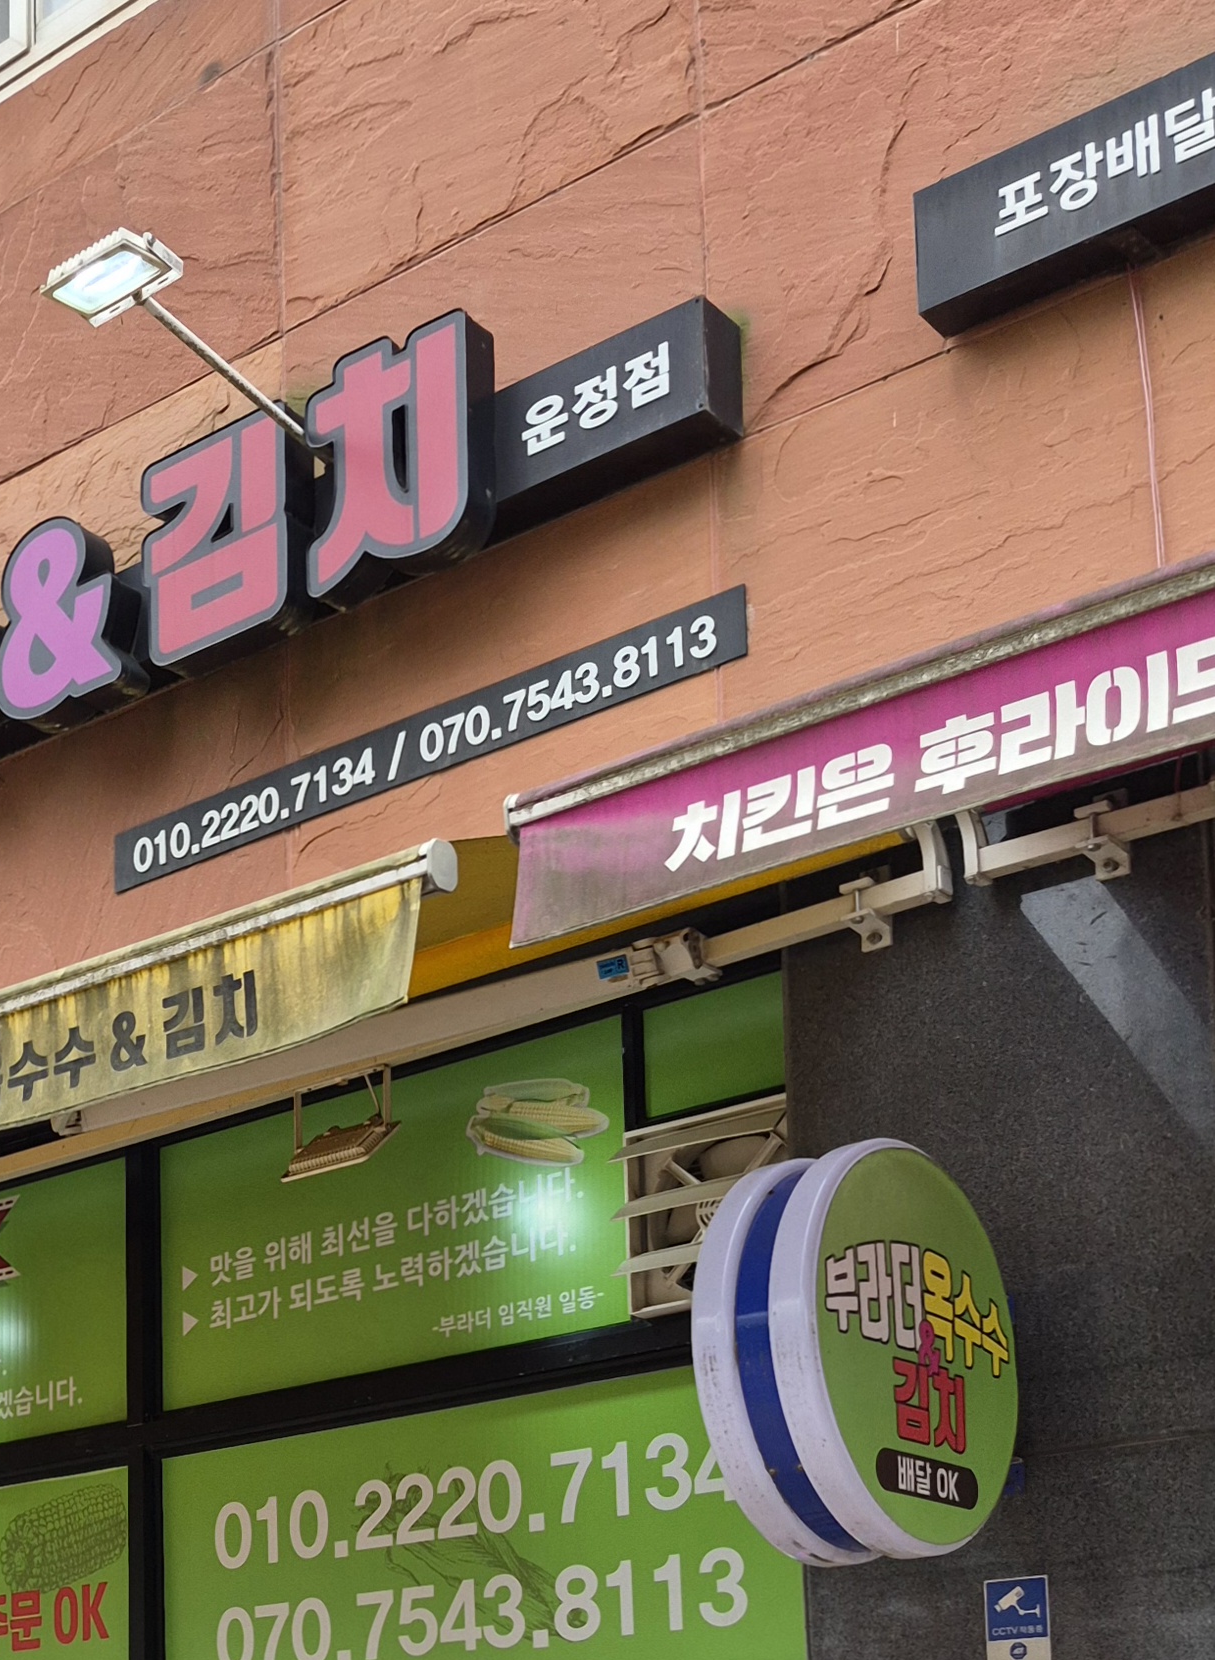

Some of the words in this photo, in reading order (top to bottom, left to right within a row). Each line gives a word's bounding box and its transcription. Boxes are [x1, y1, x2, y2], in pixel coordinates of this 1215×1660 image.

[994, 87, 1215, 237] 포장배달
[520, 341, 672, 457] 운정점
[147, 317, 461, 658] 김치
[132, 752, 376, 875] 010.2220.7134
[418, 614, 717, 765] 070.7543.8113
[663, 742, 895, 873] 치킨은
[111, 1010, 147, 1072] &
[162, 969, 258, 1060] 김치
[209, 1246, 256, 1287] 맛을
[263, 1231, 312, 1273] 위해
[320, 1211, 398, 1258] 최선을
[406, 1167, 584, 1237] 다하겠습니다.
[209, 1285, 281, 1330] 최고가
[288, 1268, 365, 1313] 되도록
[372, 1221, 577, 1293] 노력하겠습니다.
[498, 1295, 553, 1327] 임직원
[892, 1356, 967, 1455] 김치
[897, 1455, 932, 1496] 배달
[936, 1467, 960, 1502] OK
[53, 1581, 110, 1646] OK
[991, 1626, 1019, 1636] CCTV
